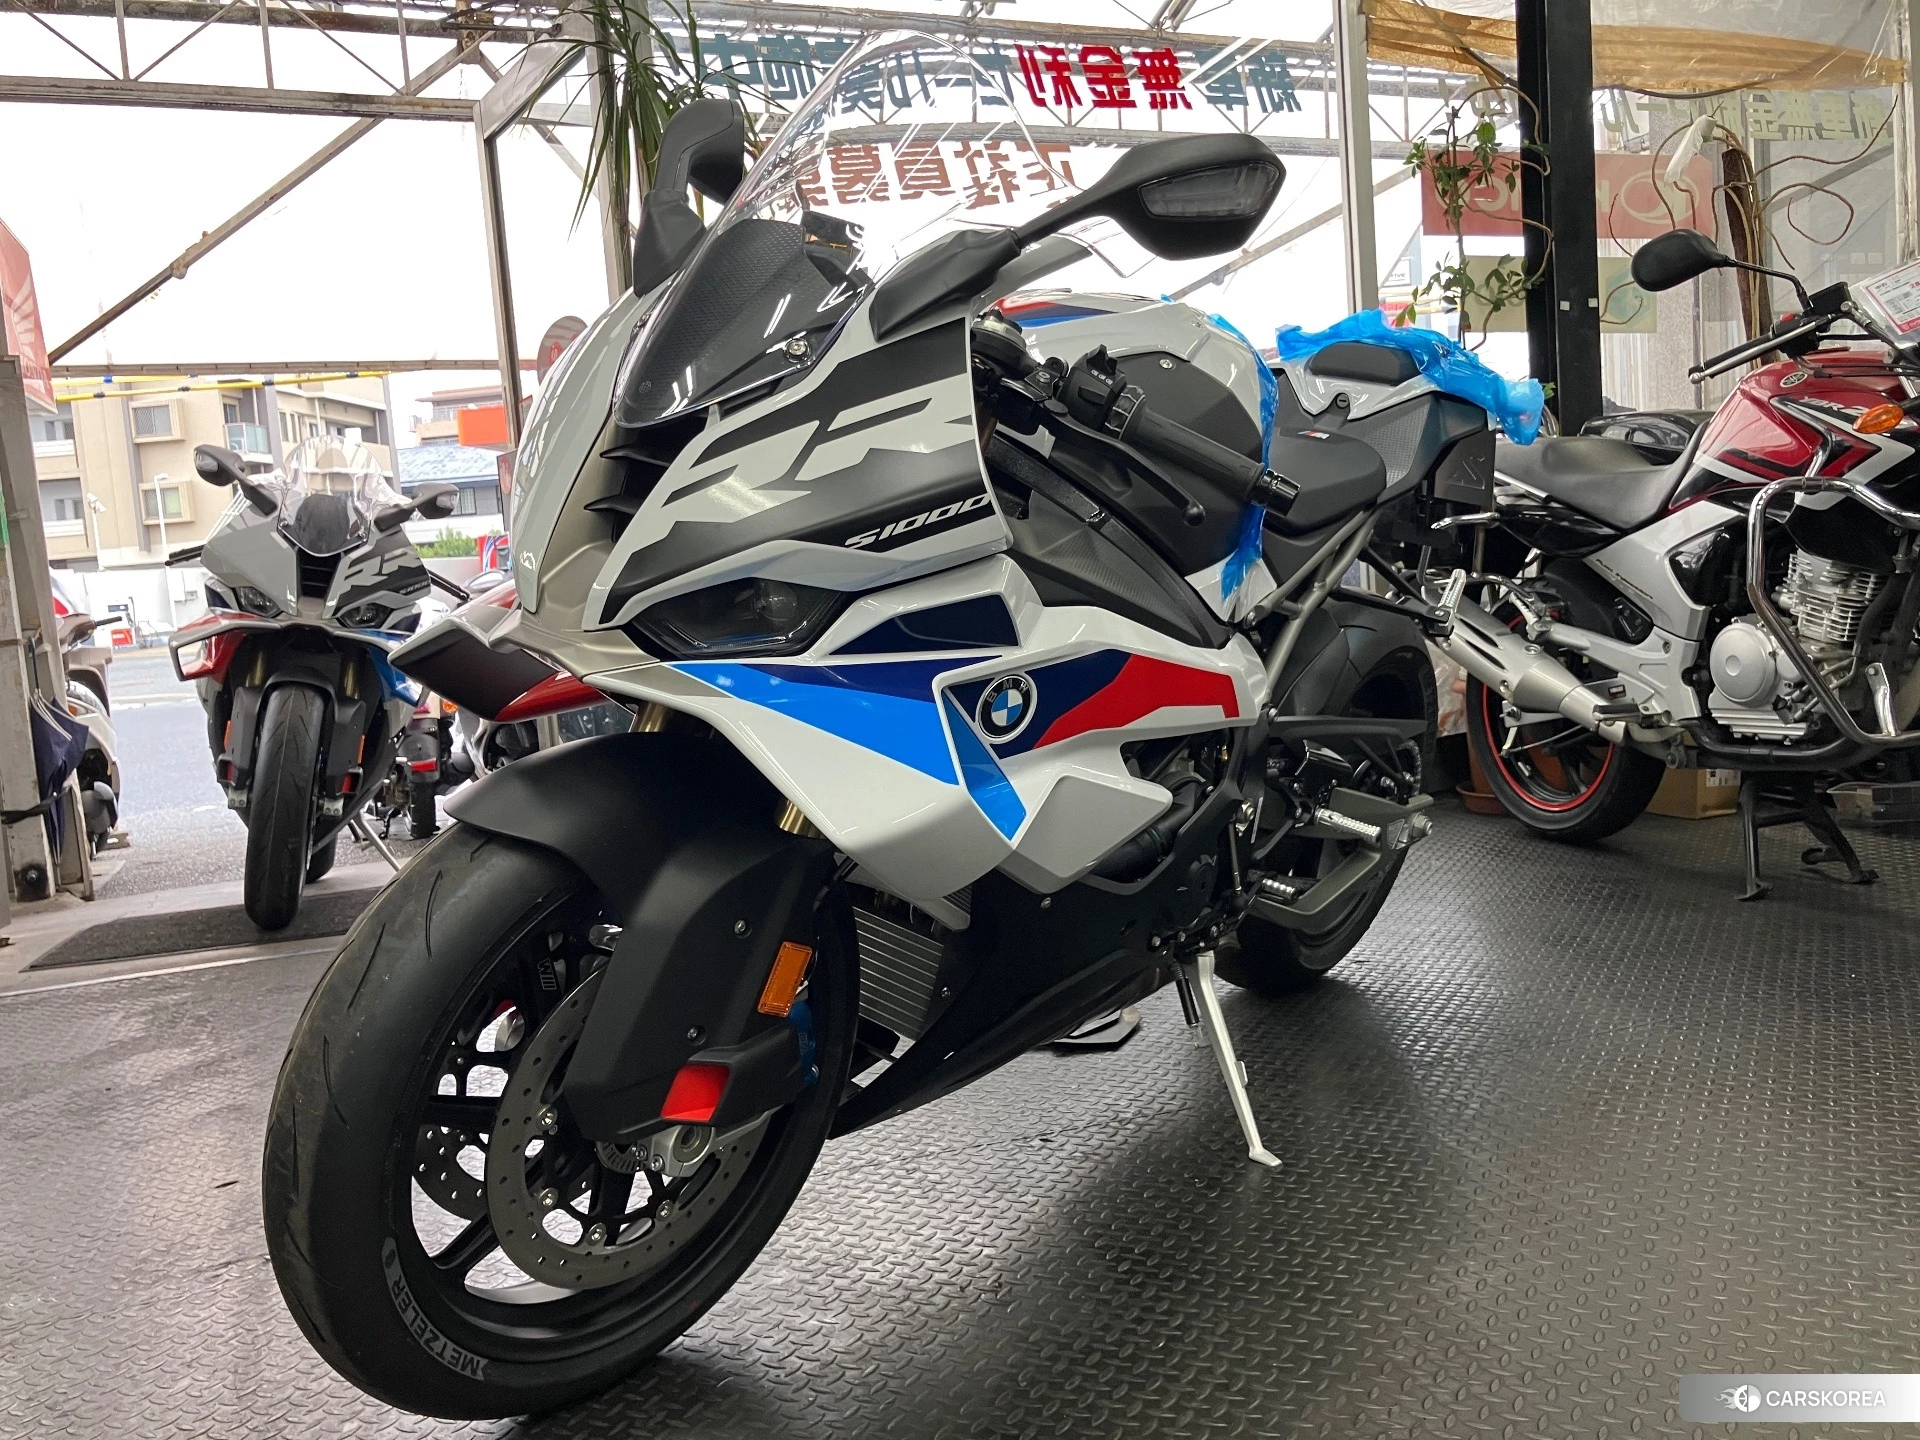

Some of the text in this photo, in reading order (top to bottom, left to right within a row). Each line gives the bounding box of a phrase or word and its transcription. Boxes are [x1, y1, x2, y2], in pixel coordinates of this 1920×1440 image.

[844, 492, 992, 550] S1000
[986, 678, 1030, 703] BMW
[391, 1273, 481, 1378] METZELER
